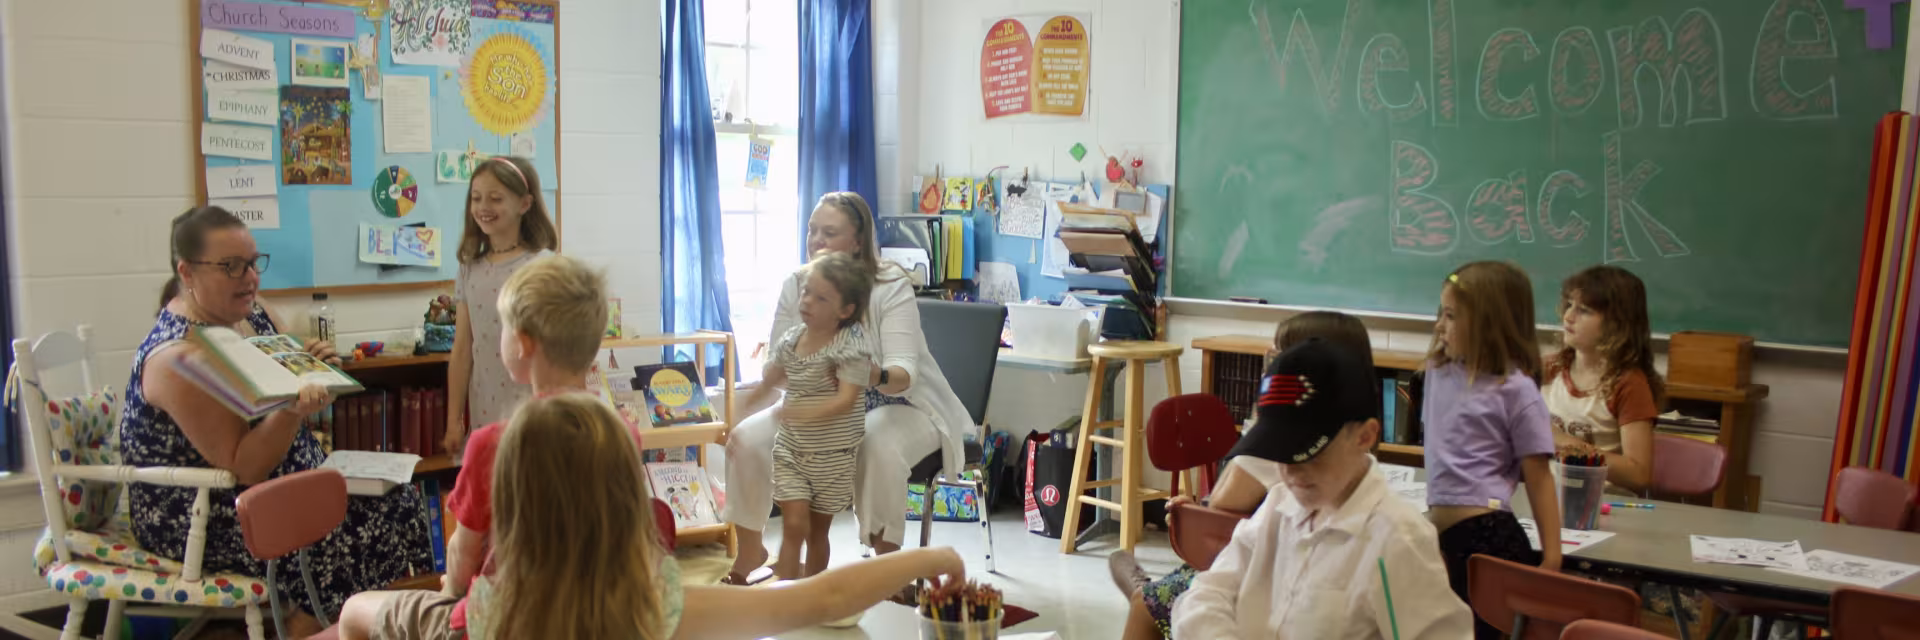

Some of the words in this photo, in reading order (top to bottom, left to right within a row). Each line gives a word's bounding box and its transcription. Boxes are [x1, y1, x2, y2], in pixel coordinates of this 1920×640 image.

[208, 3, 268, 26] Church
[279, 7, 340, 32] Seasons
[1060, 19, 1073, 33] 10
[1004, 21, 1014, 35] 10
[217, 42, 260, 60] ADVENT
[1250, 0, 1838, 127] Welcome
[212, 70, 271, 82] CHRISTMAS
[487, 67, 527, 99] Son
[219, 101, 268, 115] EPIPHANY
[209, 136, 266, 153] PENTECOST
[229, 176, 255, 189] LENT
[1391, 131, 1690, 263] Back
